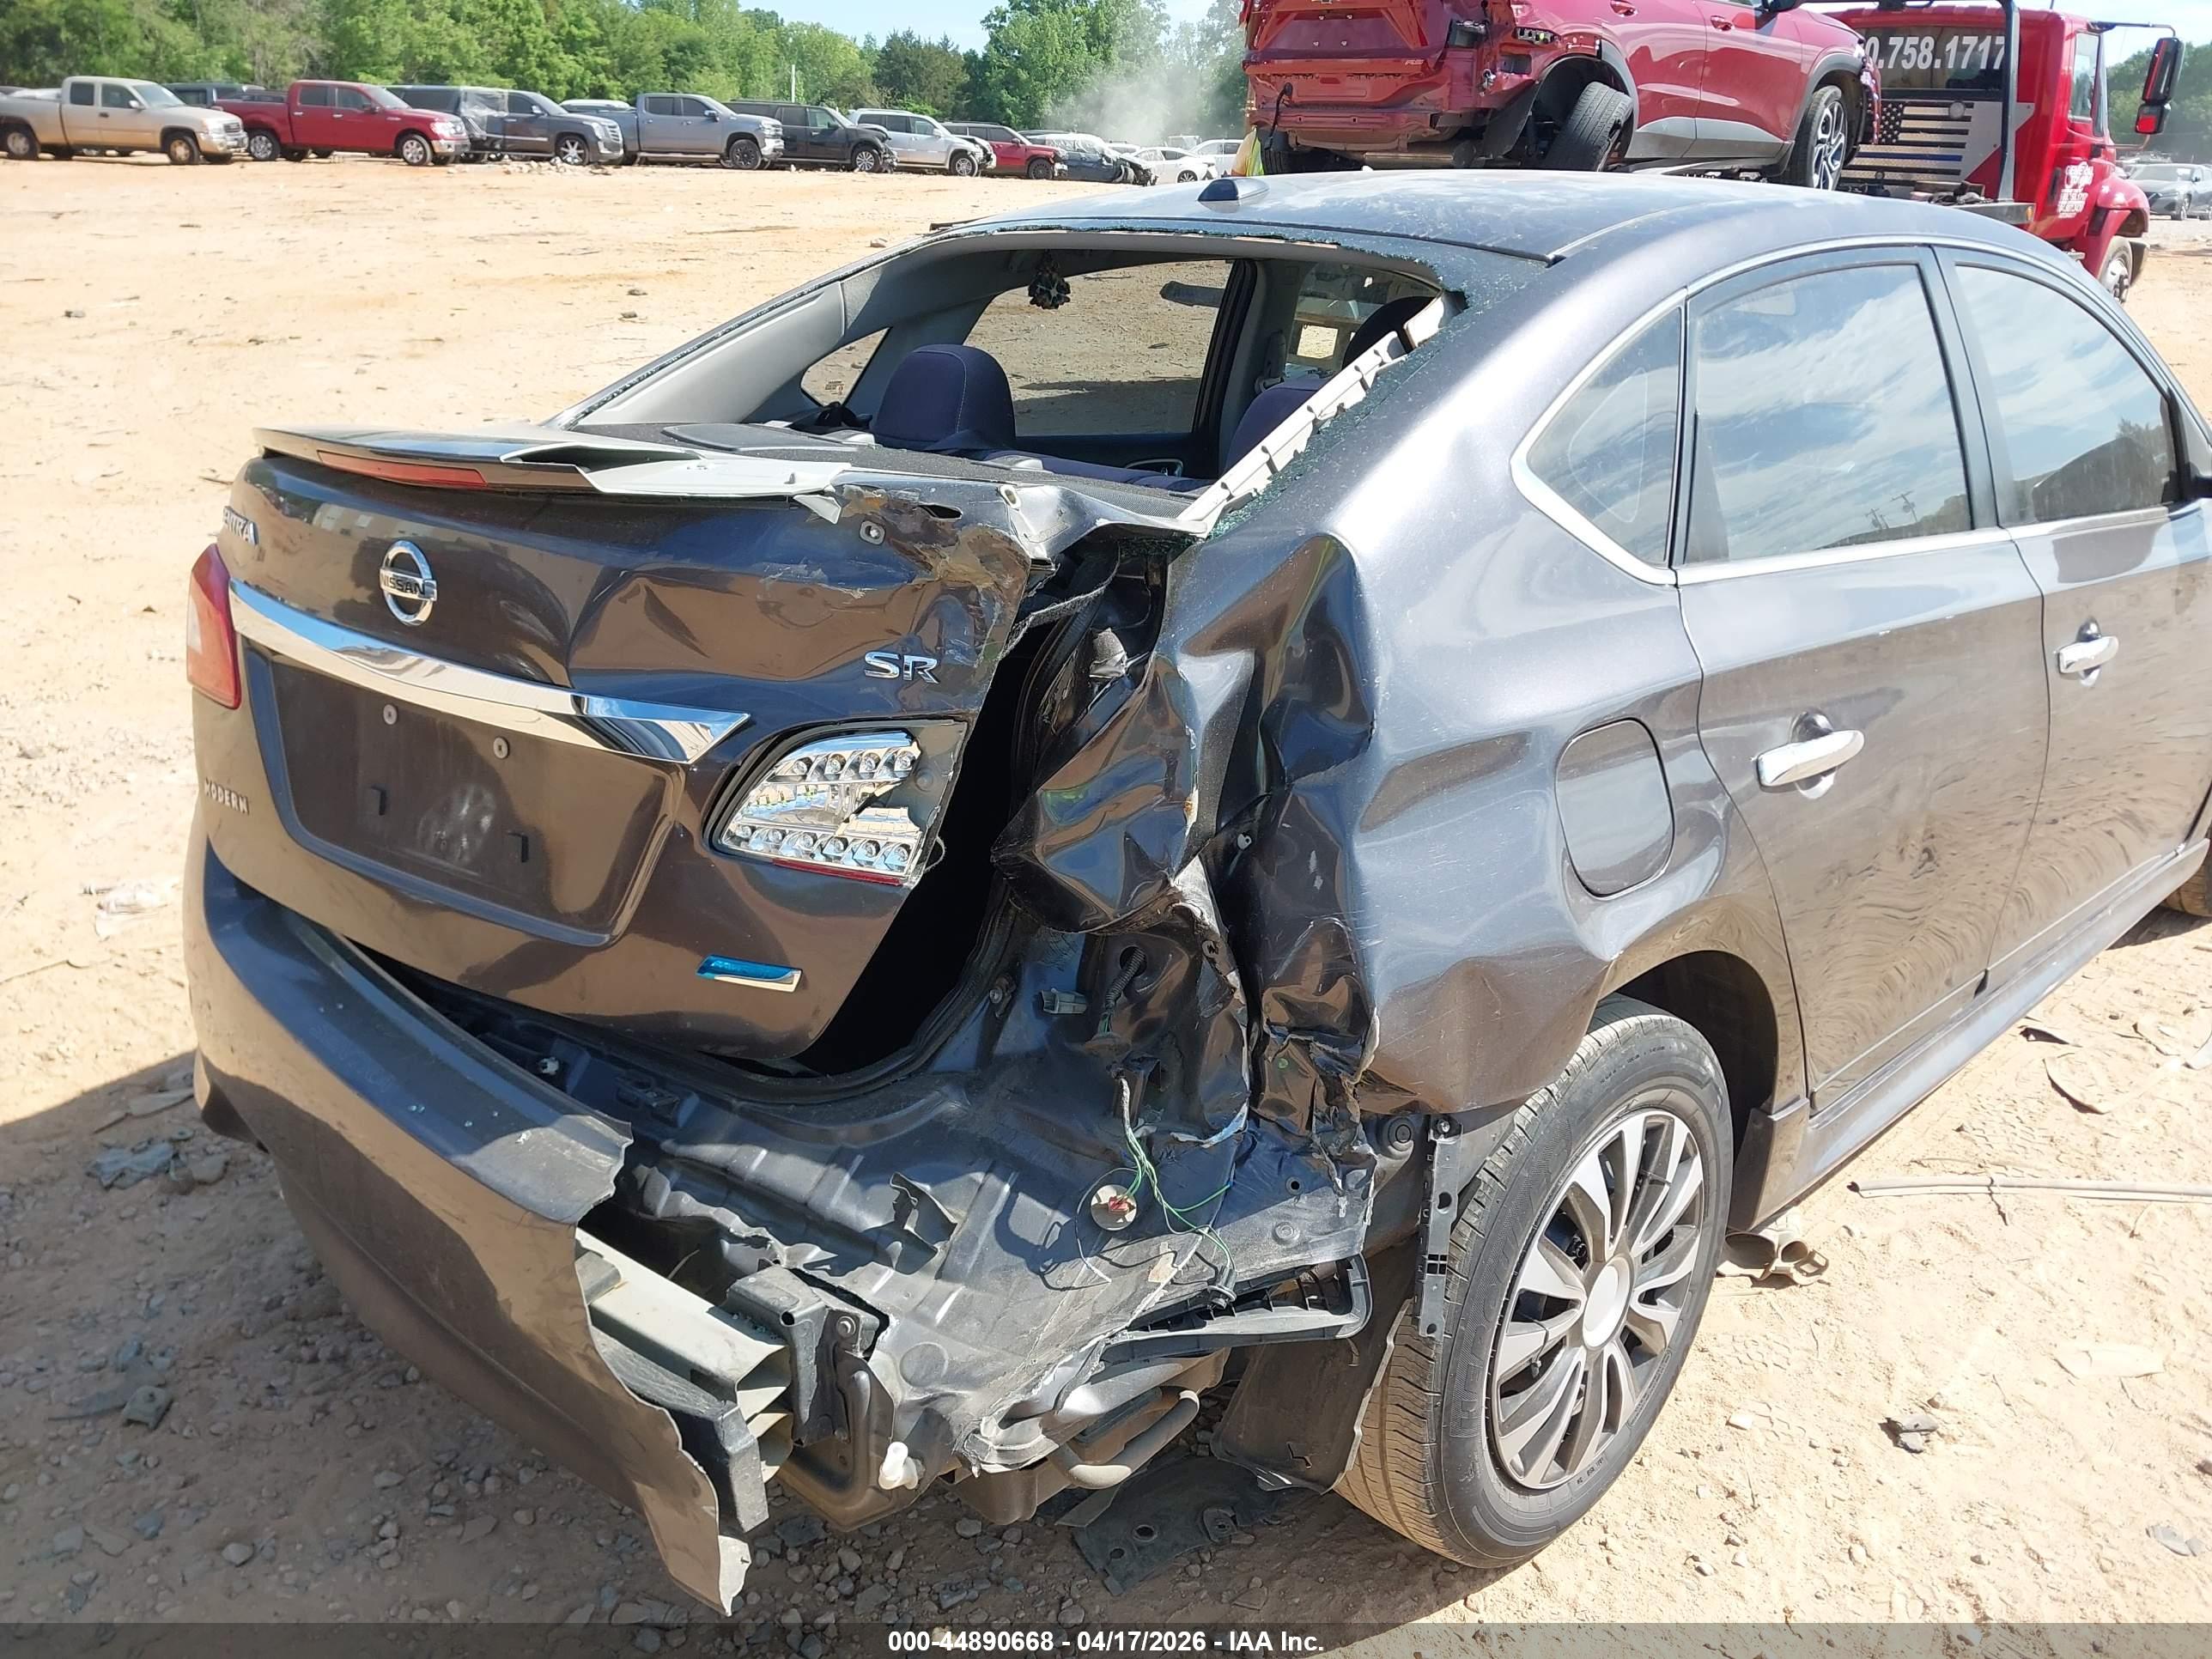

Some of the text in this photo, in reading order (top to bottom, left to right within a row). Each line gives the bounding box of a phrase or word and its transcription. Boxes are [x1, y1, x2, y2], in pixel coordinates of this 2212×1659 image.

[1865, 35, 2006, 70] 0.758.1717
[222, 506, 259, 546] ENTRA
[381, 573, 426, 595] NISSAN
[864, 651, 940, 684] SR
[204, 777, 250, 815] MODERN
